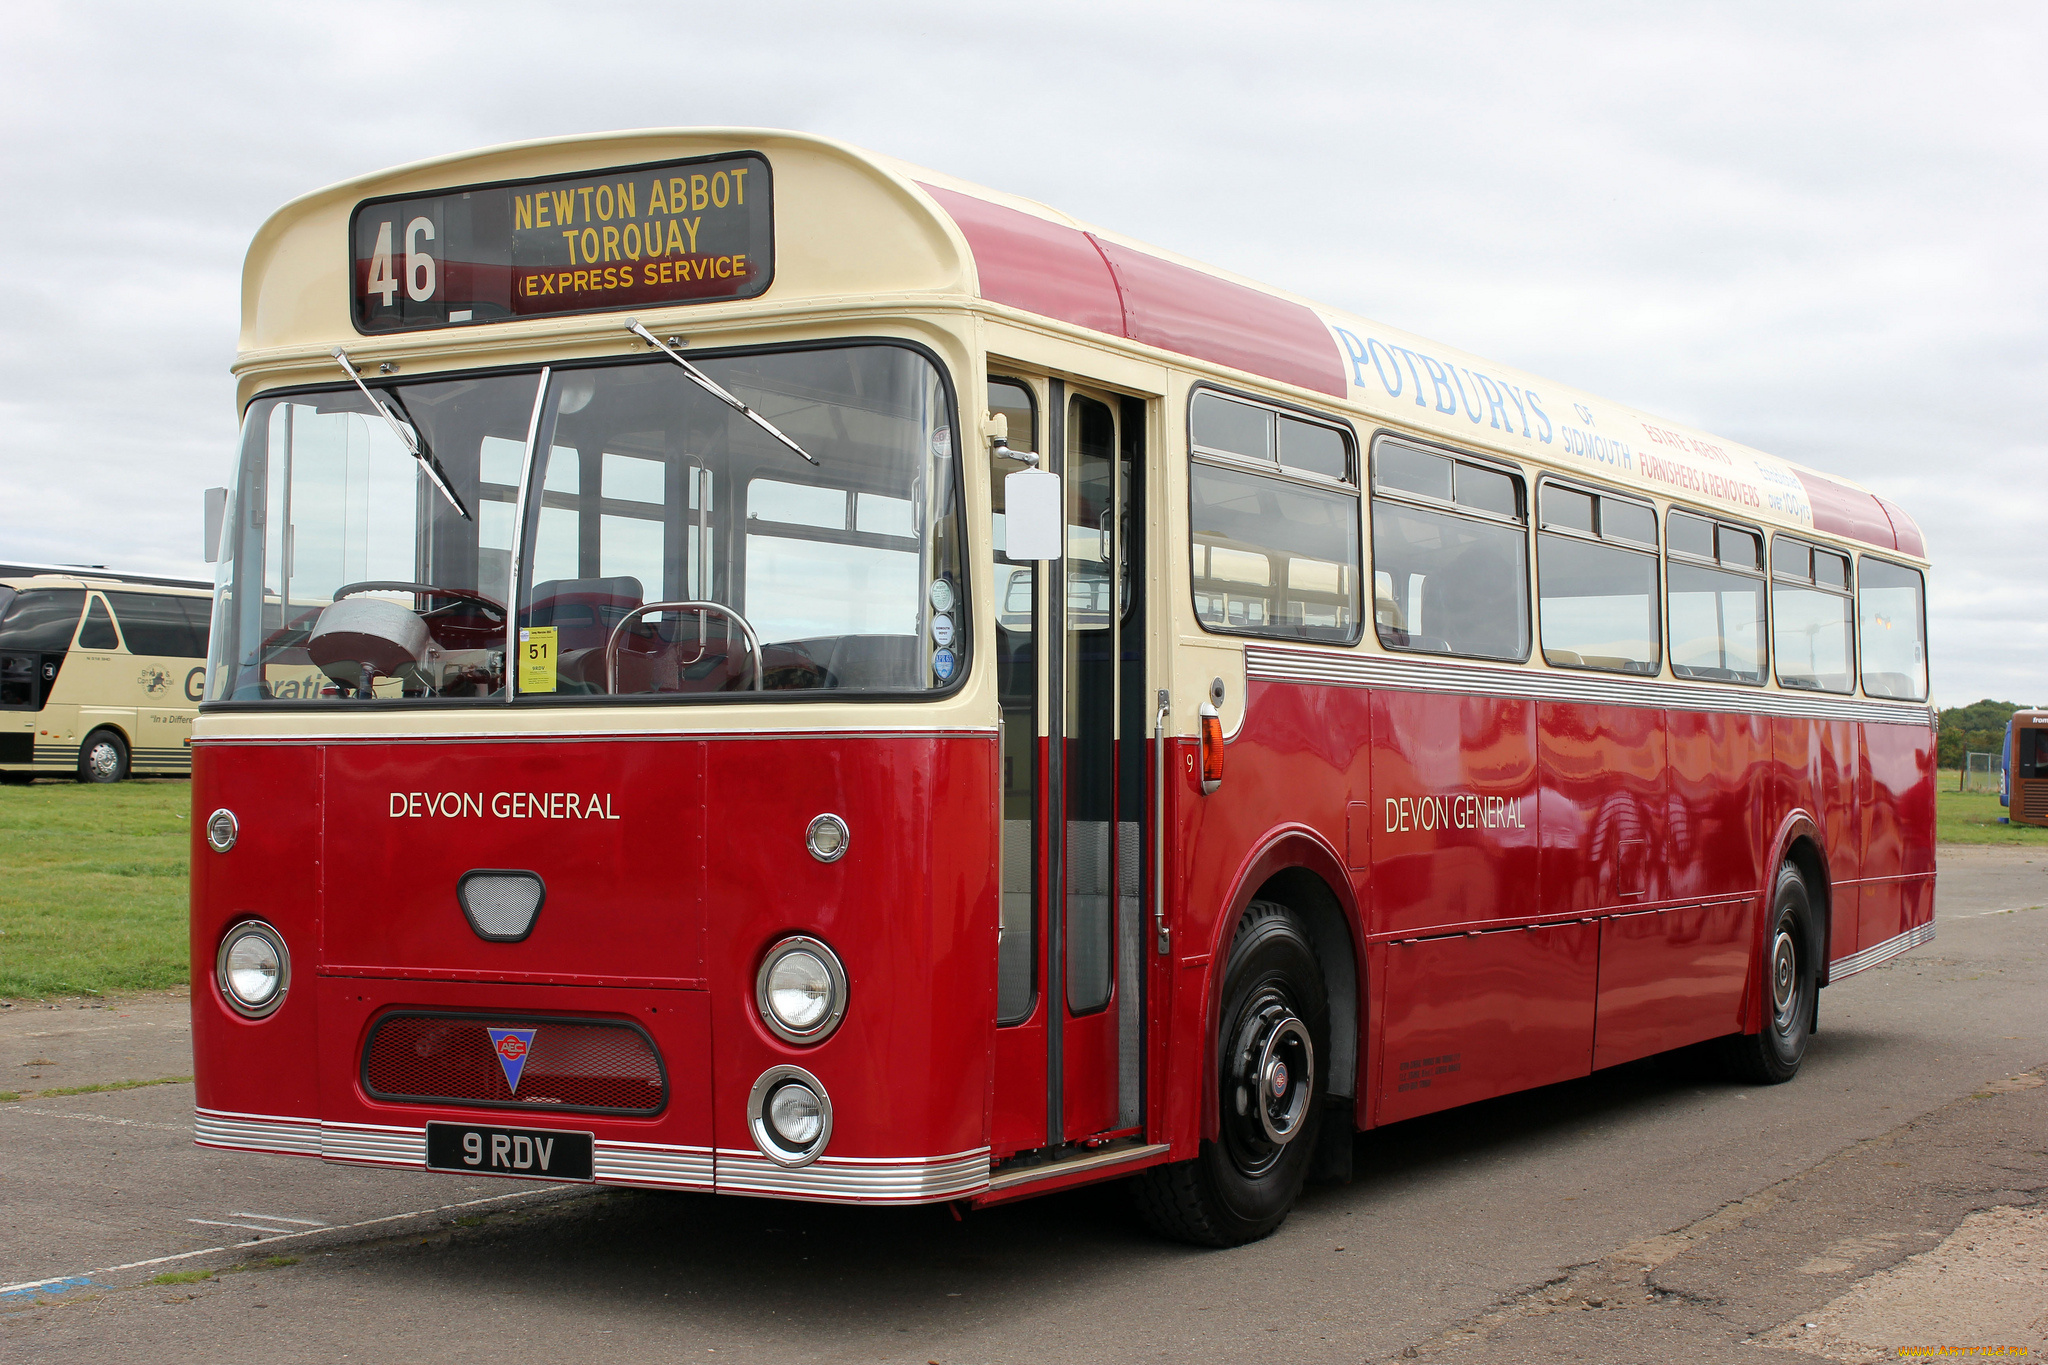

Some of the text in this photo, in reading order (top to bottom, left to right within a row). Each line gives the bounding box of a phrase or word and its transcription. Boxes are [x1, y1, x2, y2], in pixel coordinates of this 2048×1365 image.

[515, 168, 748, 230] NEWTON ABBOT
[563, 217, 701, 265] TORQUAY
[367, 216, 436, 307] 46
[644, 255, 746, 285] SERVICE
[1332, 325, 1552, 444] POTBURYS
[1573, 402, 1596, 427] OF
[1562, 426, 1632, 470] SIDMOUTH
[1641, 423, 1732, 465] ESTATE AGENTS
[1638, 452, 1760, 508] FURNISHERS & REMOVERS
[529, 643, 547, 659] 51
[168, 715, 193, 724] Differe
[1186, 754, 1193, 772] 9
[389, 791, 621, 820] DEVON GENERAL
[1385, 795, 1526, 833] DEVON GENERAL
[500, 1042, 524, 1053] AEC
[463, 1132, 554, 1171] 9 RDV
